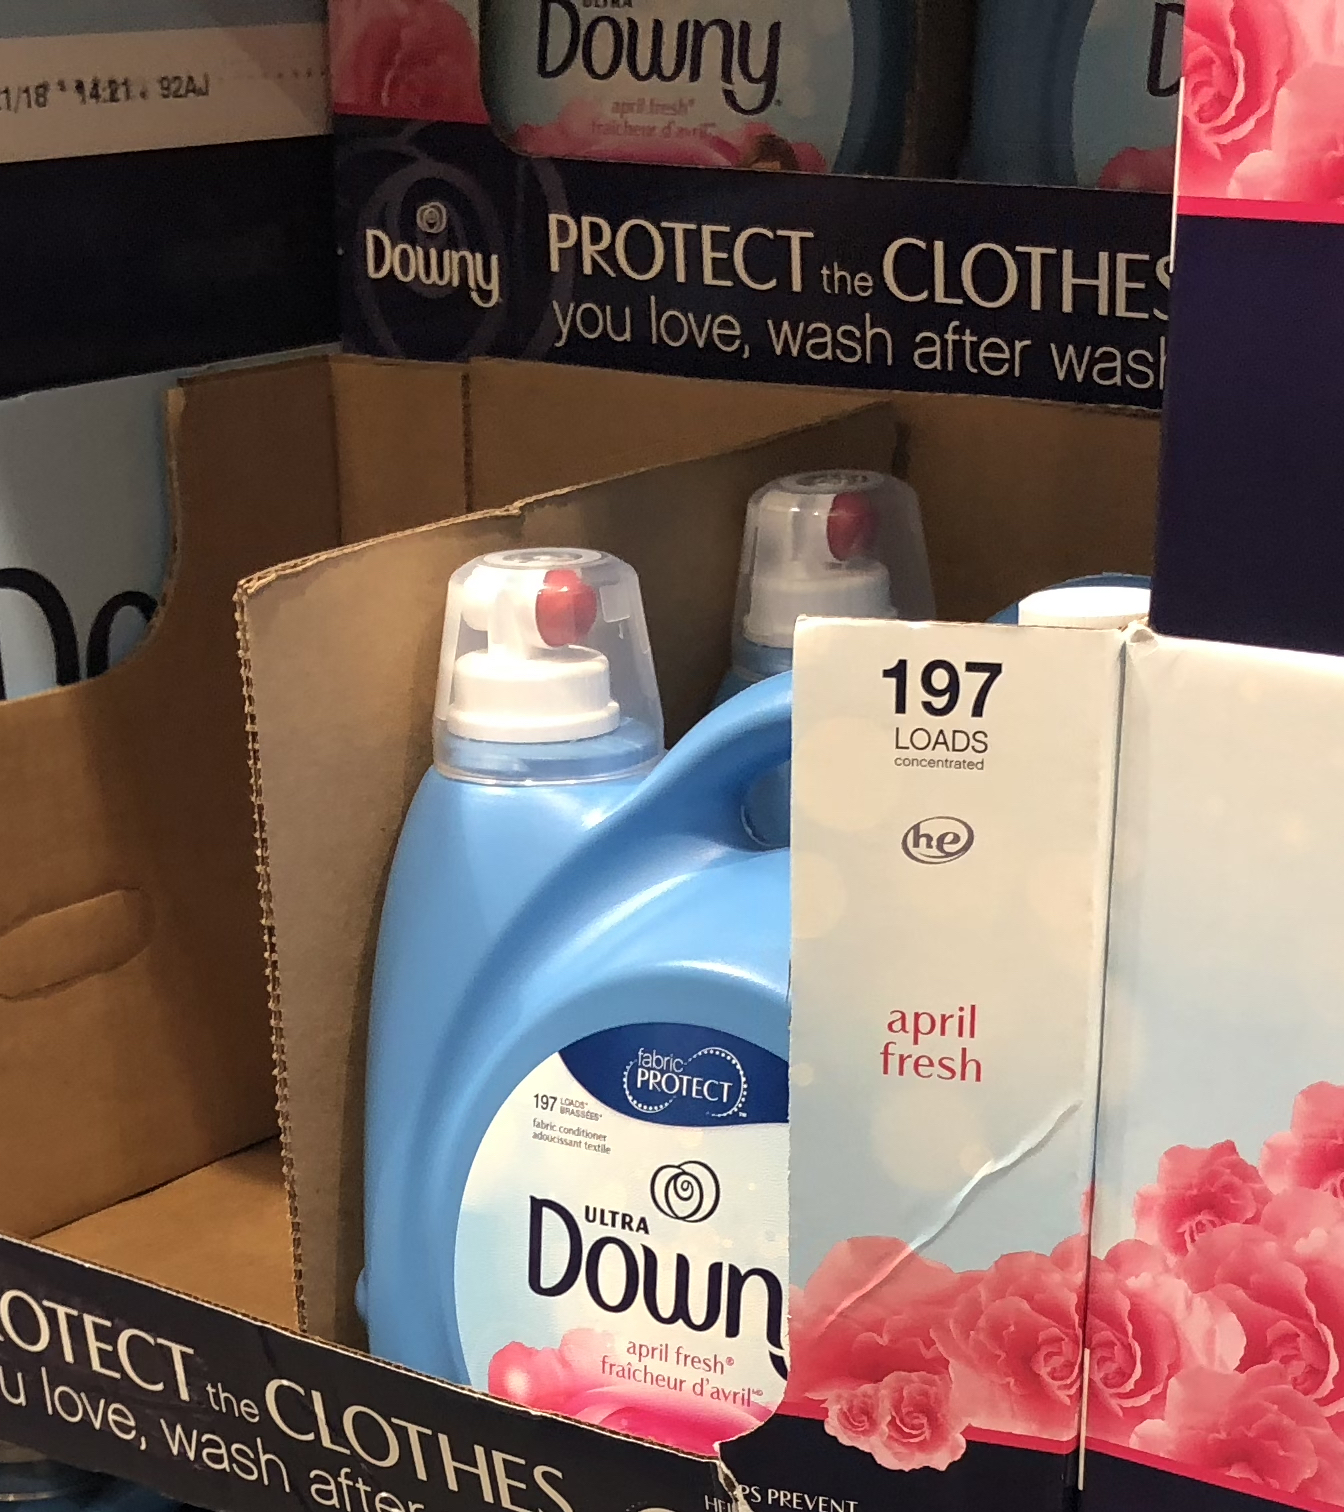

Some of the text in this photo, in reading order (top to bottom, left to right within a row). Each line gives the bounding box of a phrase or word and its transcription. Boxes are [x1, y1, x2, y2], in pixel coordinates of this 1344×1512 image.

[537, 0, 782, 116] Downy
[365, 227, 501, 308] Downy
[548, 212, 814, 294] PROTECT
[821, 264, 874, 297] the
[551, 297, 632, 347] you
[649, 293, 751, 358] love,
[766, 315, 895, 369] wash
[914, 320, 1032, 378] after
[881, 658, 1004, 719] 197
[894, 726, 990, 755] LOADS
[893, 755, 985, 771] concentrated
[886, 1003, 978, 1045] april
[637, 1046, 686, 1074] fabric
[879, 1041, 983, 1083] fresh
[533, 1092, 558, 1112] 197
[635, 1067, 734, 1105] PROTECT
[558, 1126, 608, 1142] conditioner
[585, 1205, 650, 1235] ULTRA
[626, 1336, 670, 1366] april
[600, 1354, 688, 1395] fraîcheur
[205, 1382, 261, 1424] the
[41, 1364, 148, 1453] love,
[159, 1417, 292, 1494] wash
